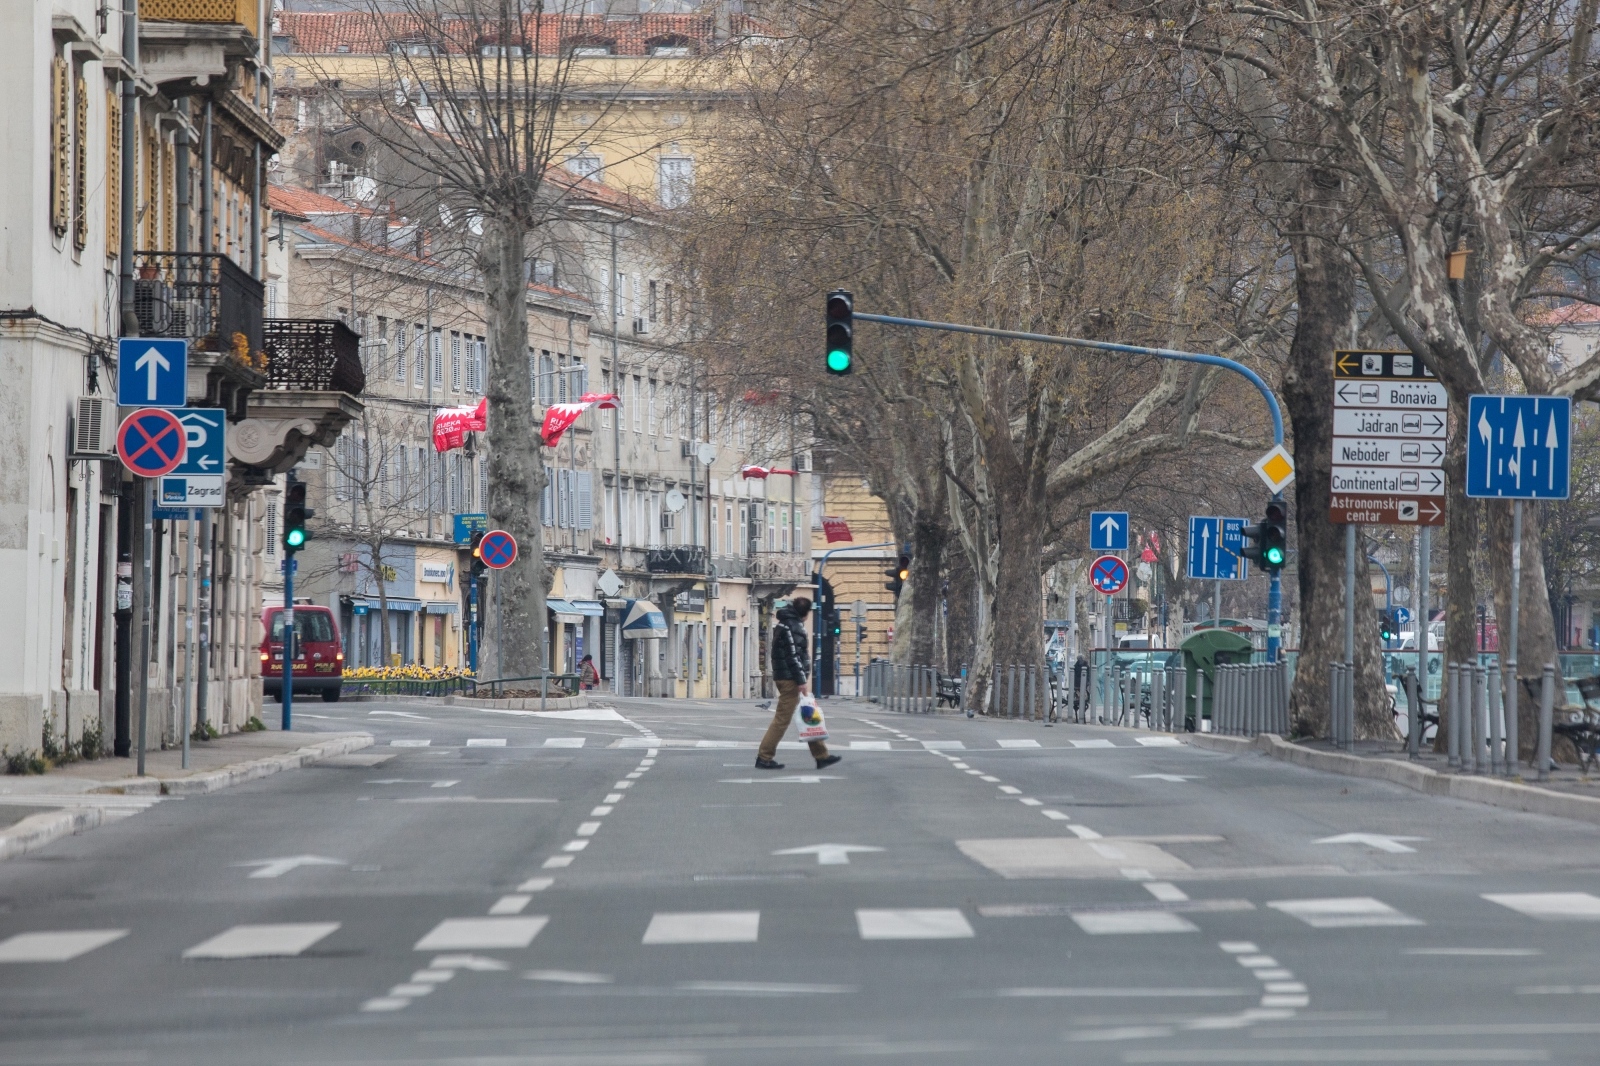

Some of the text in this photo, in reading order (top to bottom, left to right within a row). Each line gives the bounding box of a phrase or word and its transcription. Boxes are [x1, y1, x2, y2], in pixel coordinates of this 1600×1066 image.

[1390, 390, 1437, 405] Bonavia
[436, 419, 460, 430] RIJEKA
[1357, 419, 1399, 433] Jadran
[1342, 446, 1390, 461] Neboder
[1332, 475, 1398, 491] Continental
[188, 486, 221, 497] Zagrad
[1331, 496, 1398, 510] Astronomski
[1346, 510, 1381, 522] centar
[1227, 523, 1239, 531] BUS
[1225, 533, 1240, 541] TAXI
